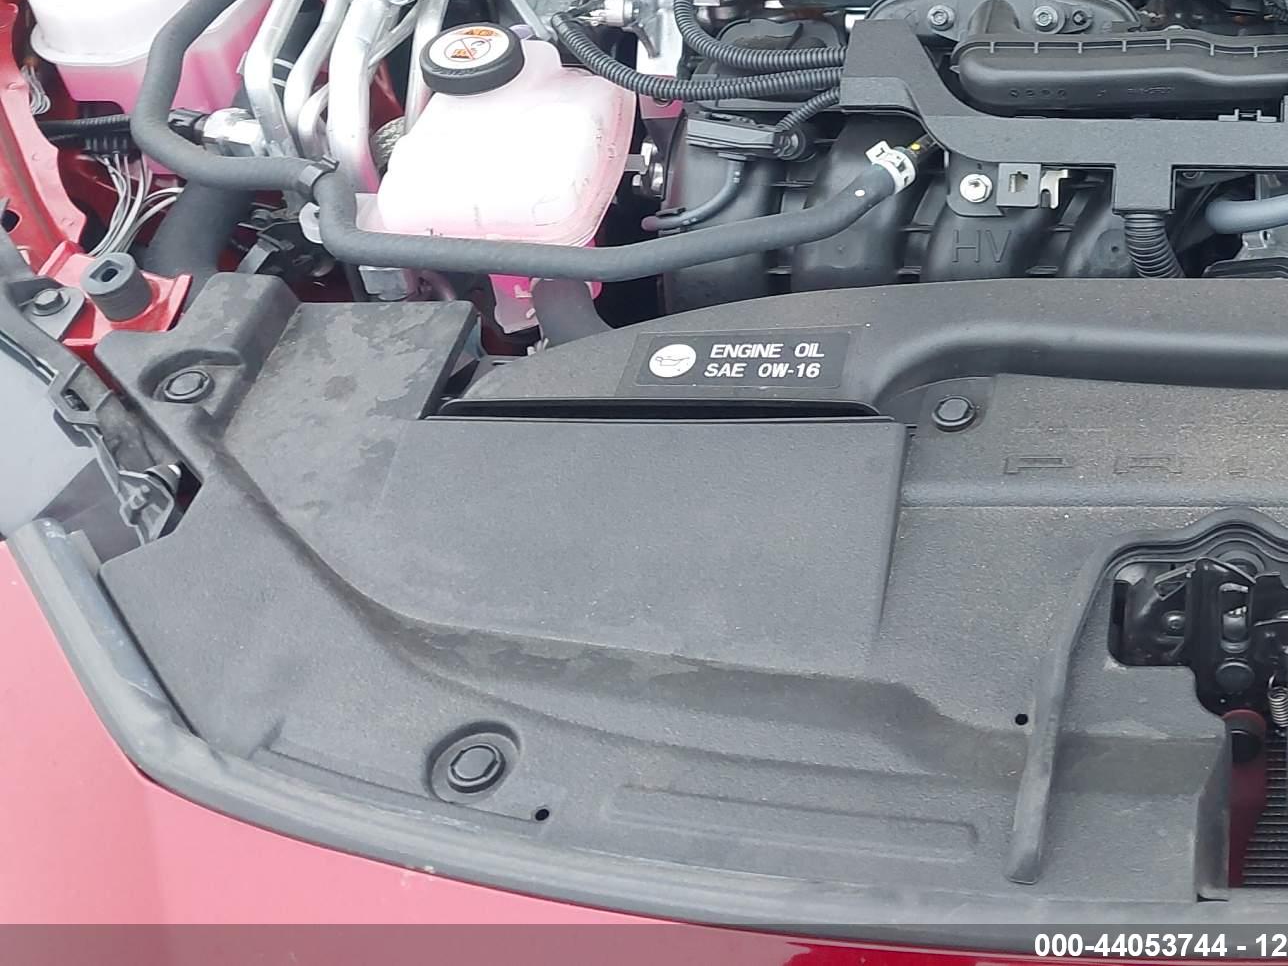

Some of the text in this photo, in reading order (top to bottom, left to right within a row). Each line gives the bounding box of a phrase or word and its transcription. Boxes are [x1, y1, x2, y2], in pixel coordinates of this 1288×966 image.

[951, 229, 1012, 264] HV
[709, 342, 825, 359] ENGINE OIL
[703, 362, 821, 378] SAE 0W-16
